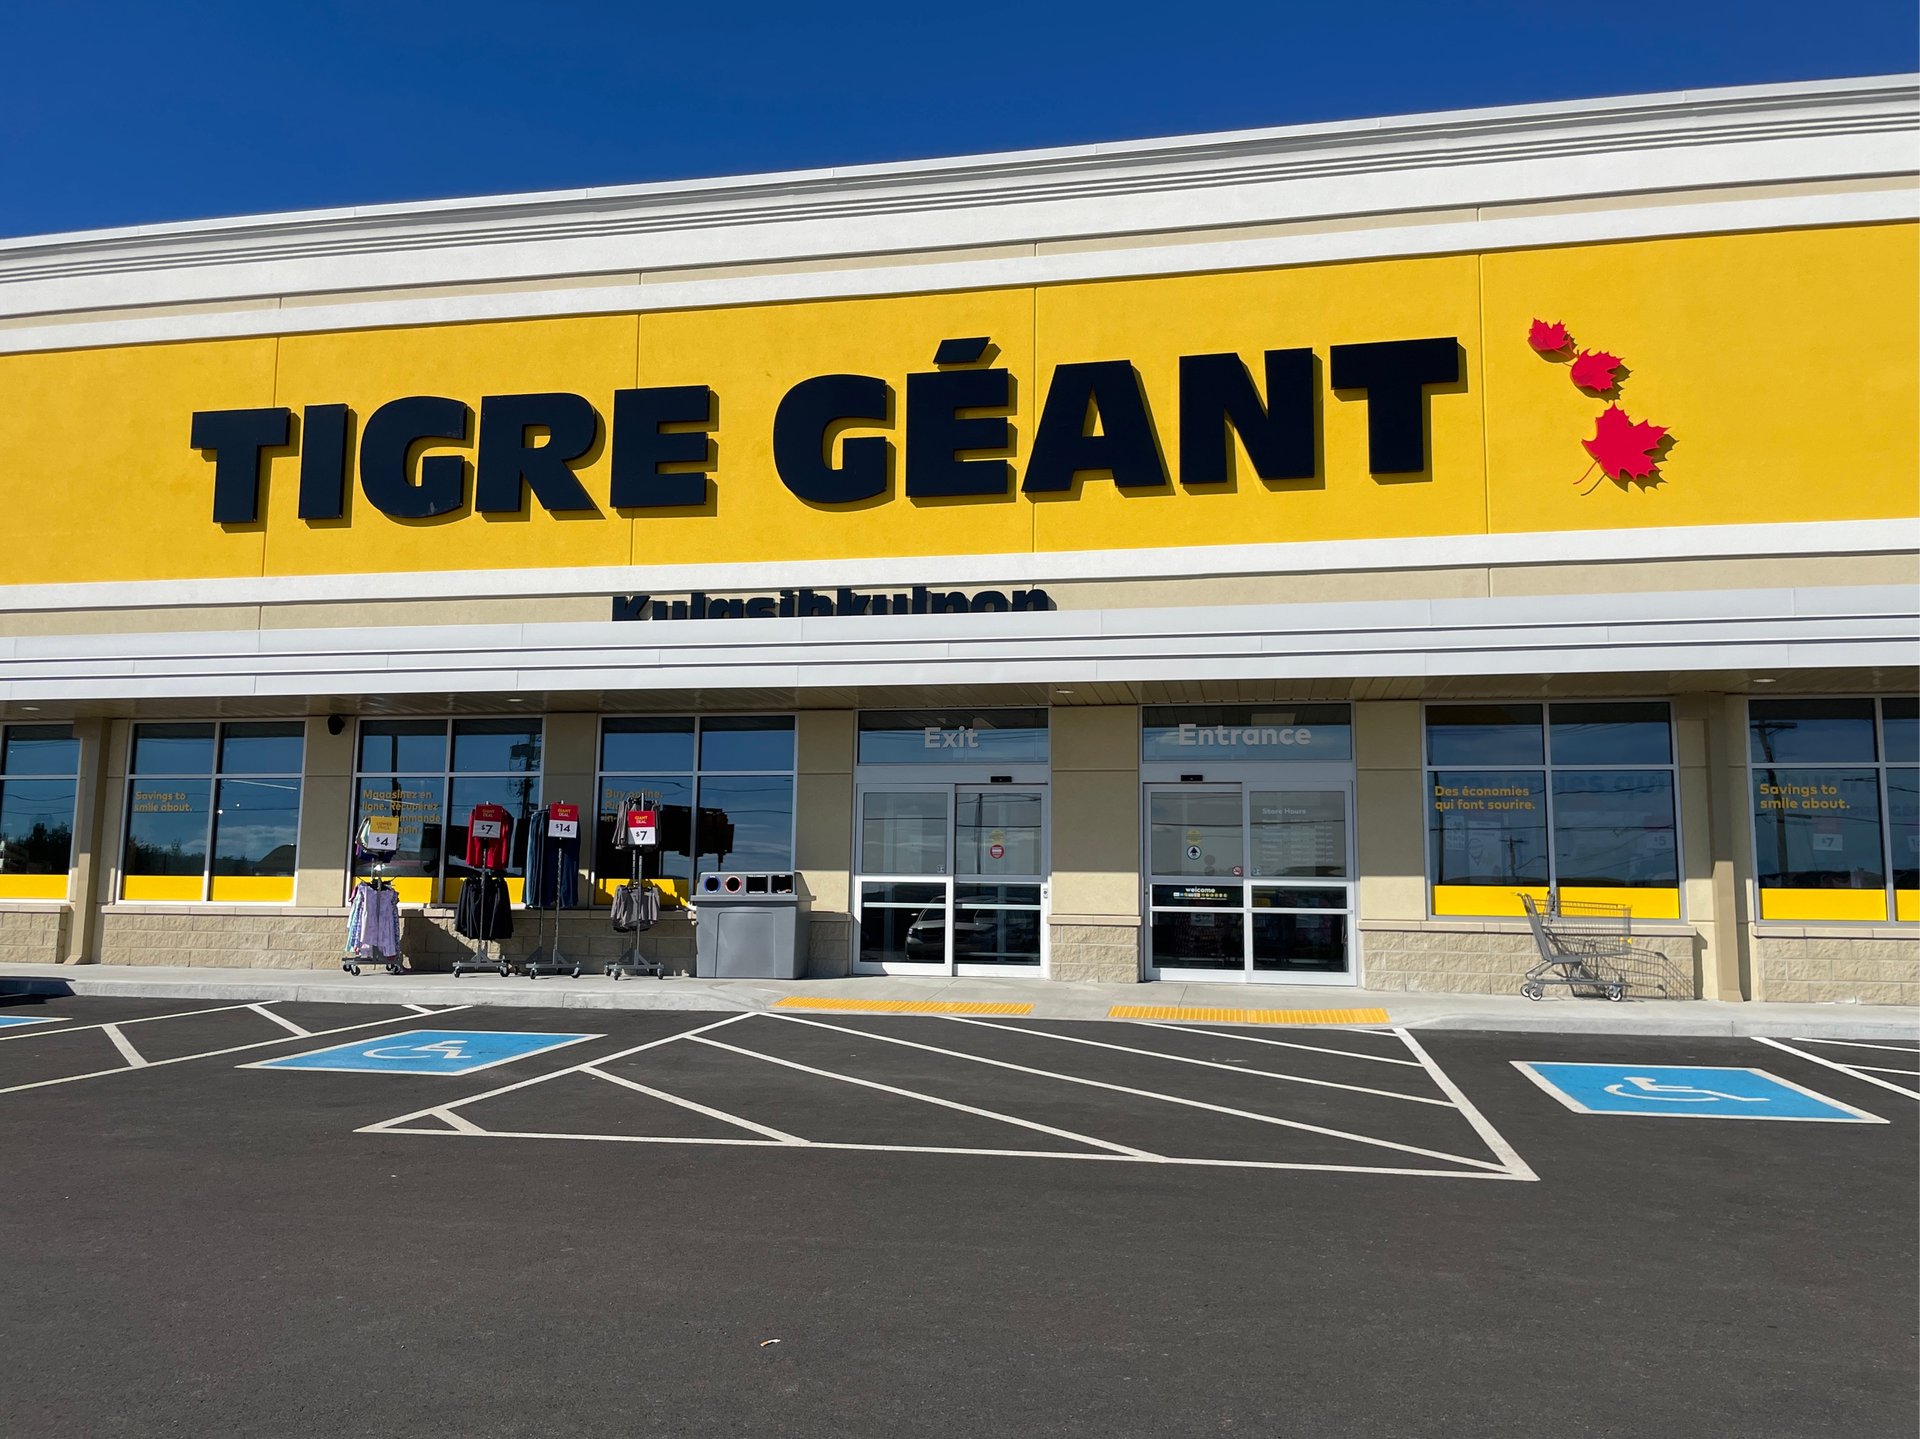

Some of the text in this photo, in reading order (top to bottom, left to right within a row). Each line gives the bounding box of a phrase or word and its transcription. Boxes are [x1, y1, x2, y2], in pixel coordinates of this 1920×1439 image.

[190, 336, 1459, 524] TIGRE GÉANT
[925, 726, 979, 748] Exit
[1178, 723, 1312, 745] Entrance
[363, 789, 432, 800] Magasinez en
[1434, 785, 1530, 797] Des économies
[1759, 783, 1818, 797] Savings
[1820, 784, 1837, 795] to
[135, 791, 186, 802] Savings to
[135, 802, 193, 812] smile about.
[362, 801, 387, 812] ligne.
[1434, 799, 1536, 812] qui font sourire.
[1760, 798, 1850, 809] smile about.
[481, 824, 494, 835] $7
[555, 823, 571, 833] $14
[635, 830, 648, 841] $7
[375, 836, 389, 847] $4
